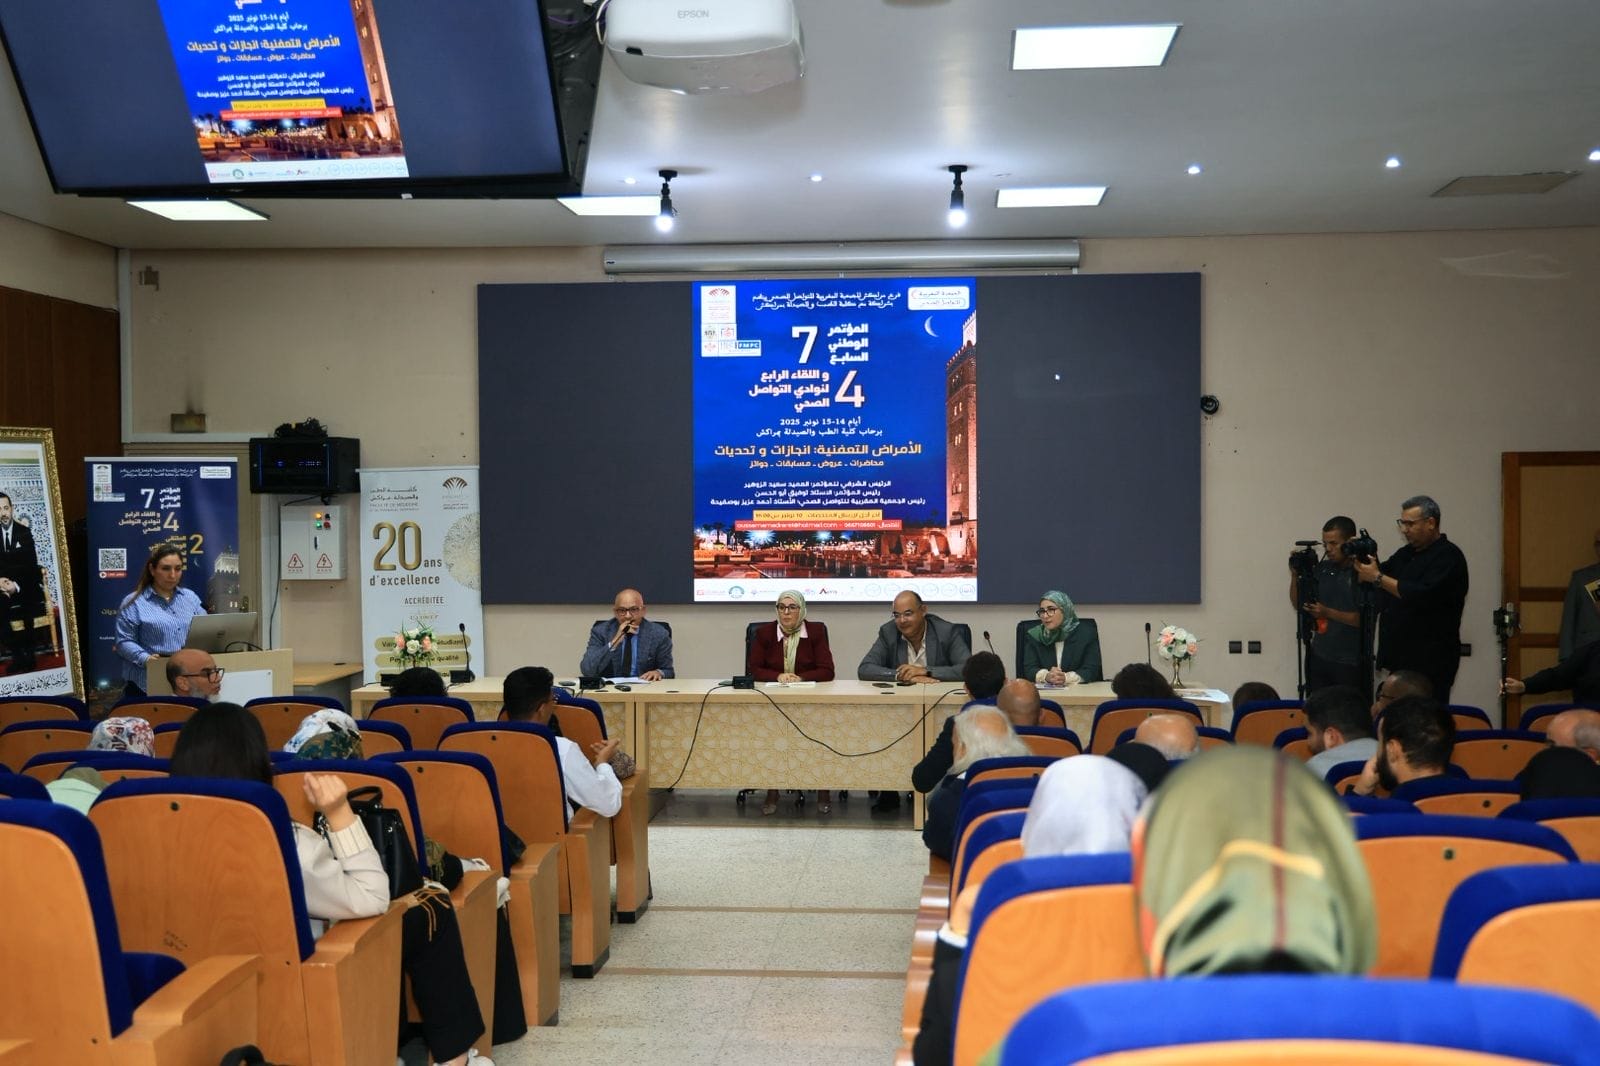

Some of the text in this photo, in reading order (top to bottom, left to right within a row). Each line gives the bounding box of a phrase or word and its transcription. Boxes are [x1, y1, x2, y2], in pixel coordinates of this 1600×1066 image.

[677, 10, 709, 19] EPSON
[187, 41, 218, 53] تحديات
[220, 43, 227, 52] و
[304, 35, 340, 50] الأمراض
[827, 323, 868, 337] المؤتمر
[792, 326, 817, 363] 7
[828, 338, 868, 353] الوطني
[830, 351, 868, 365] السابع
[761, 370, 829, 382] و اللقاء الرابع
[749, 384, 829, 400] لنوادي التواصل
[835, 370, 865, 407] 4
[794, 397, 830, 413] الصحي
[848, 416, 861, 427] أيام
[756, 426, 882, 437] برحاب كلية الطب والصيدلة بمراكش
[715, 441, 921, 457] الأمراض التعفنية: انجازات و تحديات
[750, 460, 768, 468] جوائز
[776, 460, 811, 468] مسابقات
[818, 460, 842, 468] عروض
[840, 481, 866, 489] الشرفي
[141, 489, 154, 508] 7
[755, 490, 777, 499] الحسن
[778, 489, 786, 497] أبو
[788, 490, 808, 498] توفيق
[163, 512, 179, 531] 4
[190, 534, 204, 554] 2
[372, 521, 442, 571] 20 ans
[370, 574, 440, 586] d'excellence
